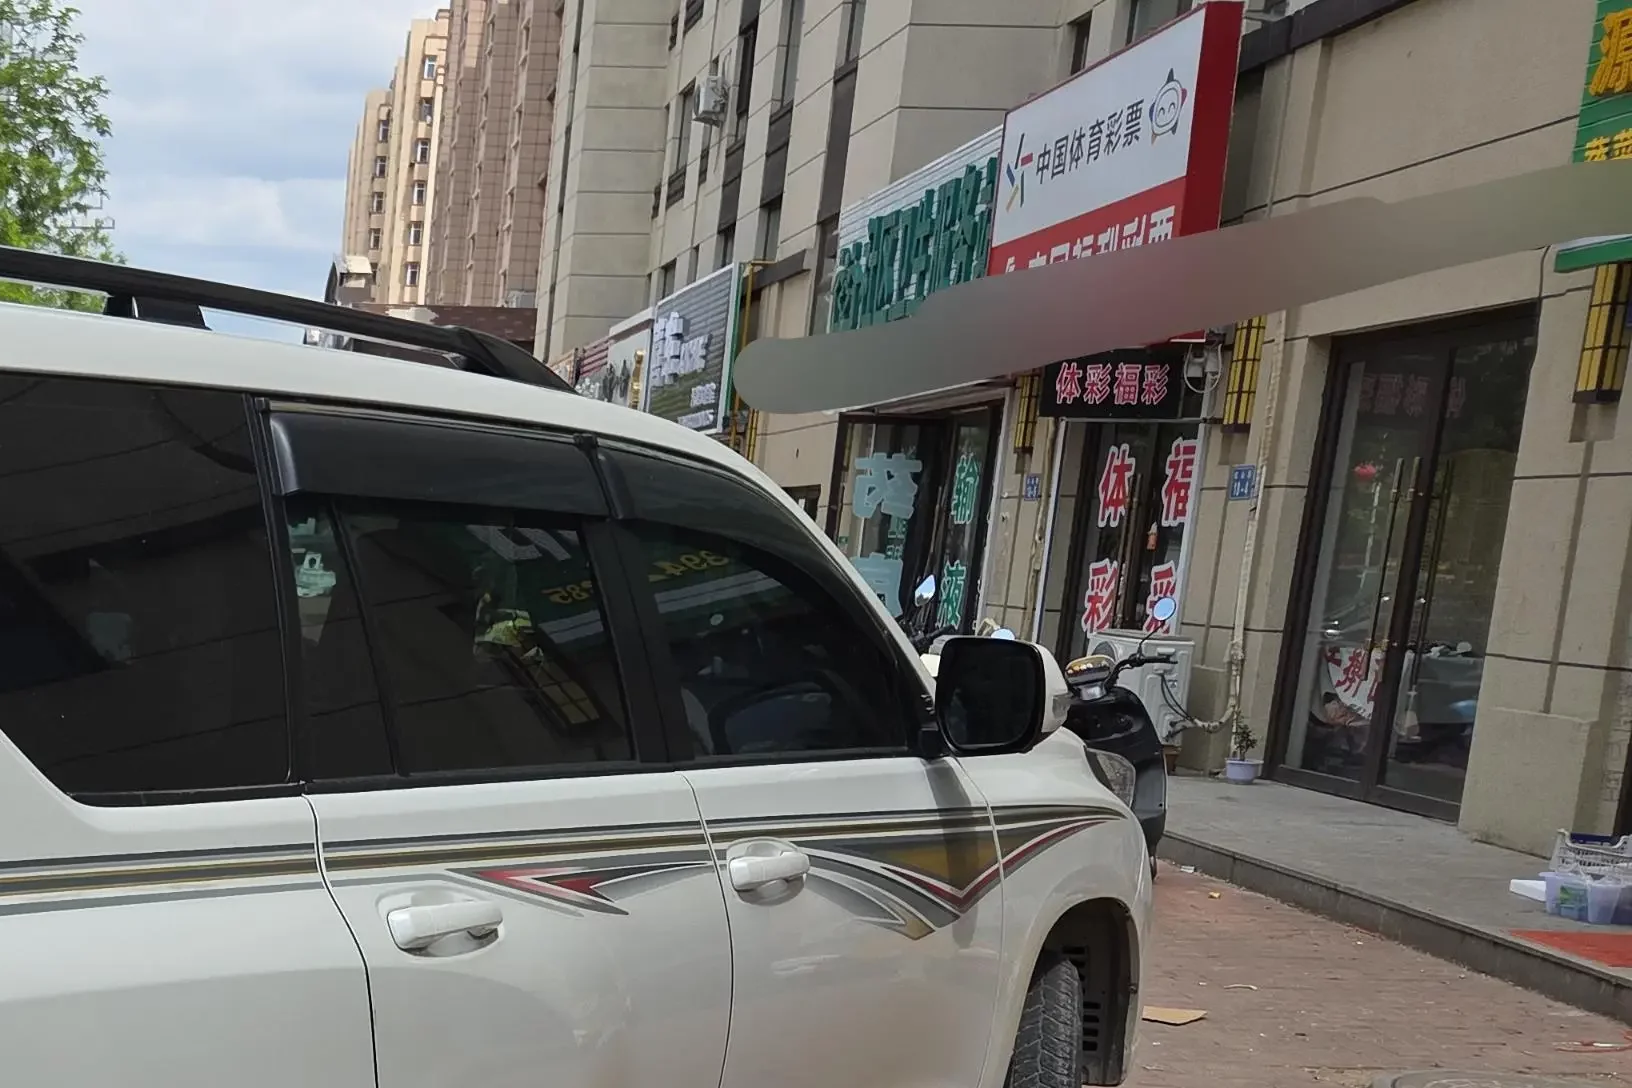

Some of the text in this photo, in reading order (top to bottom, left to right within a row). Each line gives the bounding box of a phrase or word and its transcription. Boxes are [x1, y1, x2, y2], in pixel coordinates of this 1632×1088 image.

[1035, 98, 1144, 184] 中国体育彩票
[1055, 361, 1169, 405] 体彩福彩
[936, 452, 980, 631] 输液
